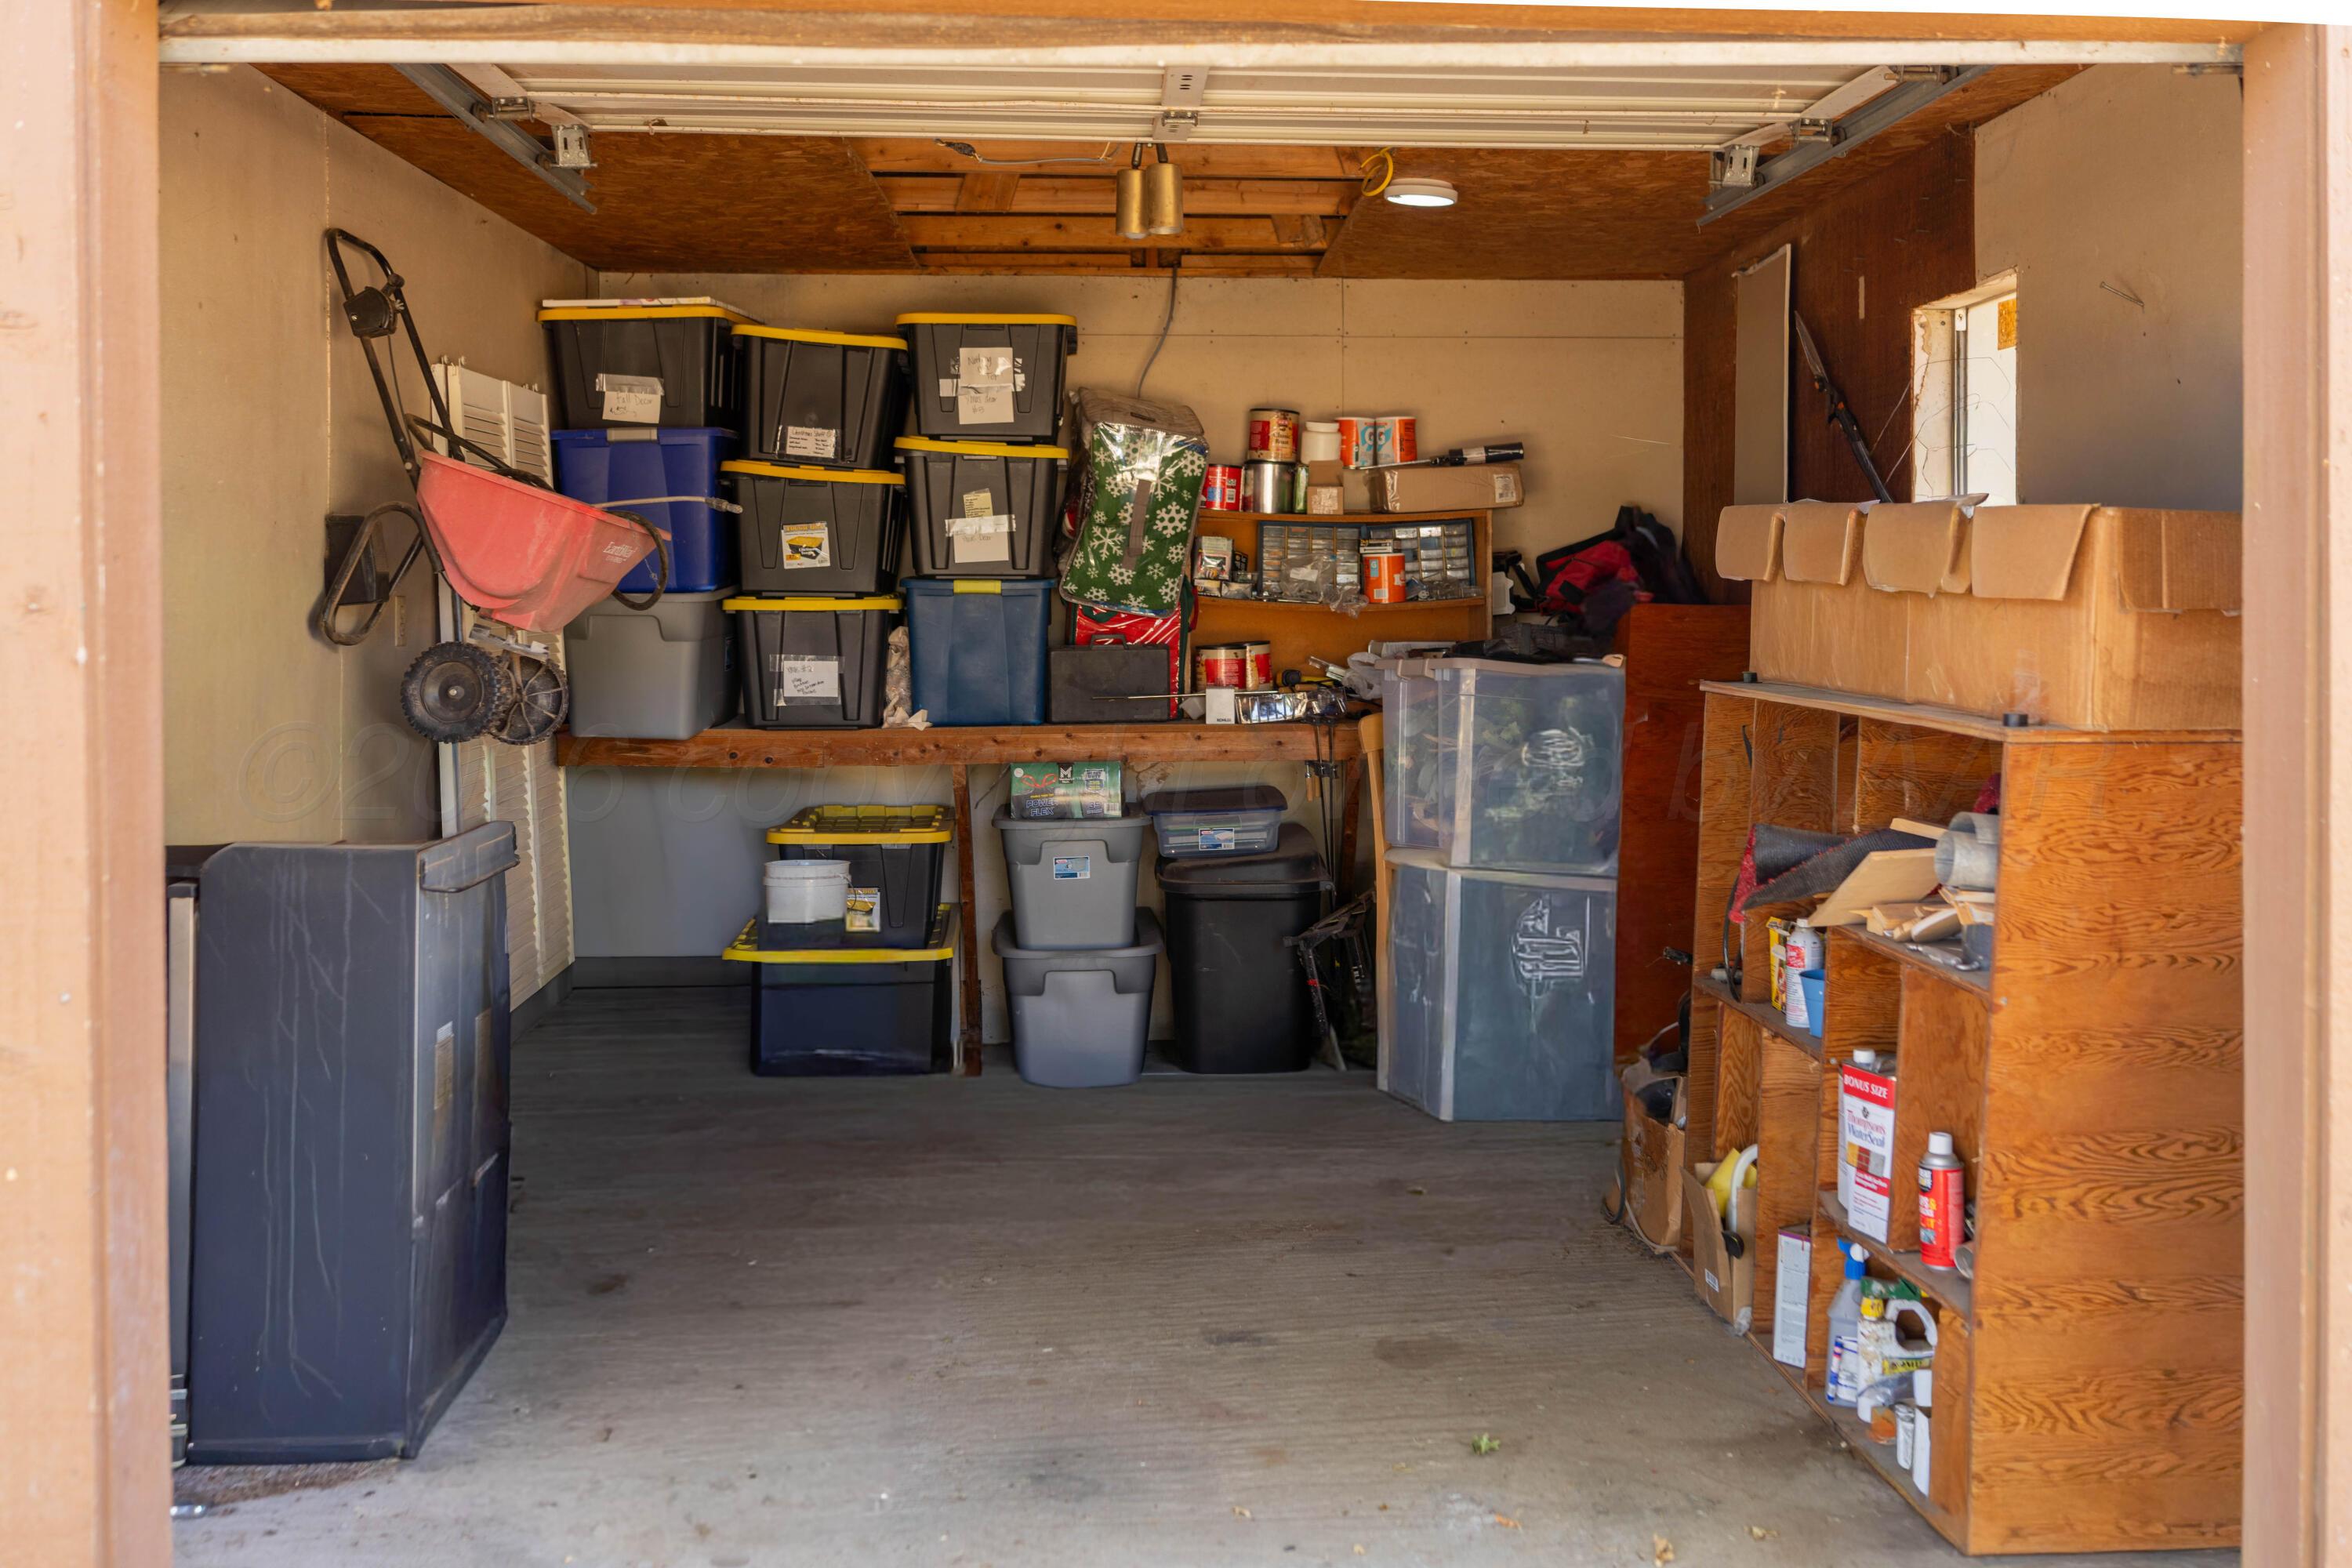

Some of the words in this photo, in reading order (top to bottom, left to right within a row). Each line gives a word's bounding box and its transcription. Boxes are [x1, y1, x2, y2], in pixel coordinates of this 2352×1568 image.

[1025, 798, 1058, 808] POWER
[1030, 807, 1054, 816] FLEX
[1843, 1073, 1870, 1094] BONUS
[1870, 1080, 1889, 1099] SIZE
[1846, 1109, 1886, 1136] Thompson's
[1847, 1121, 1886, 1149] WaterSeal
